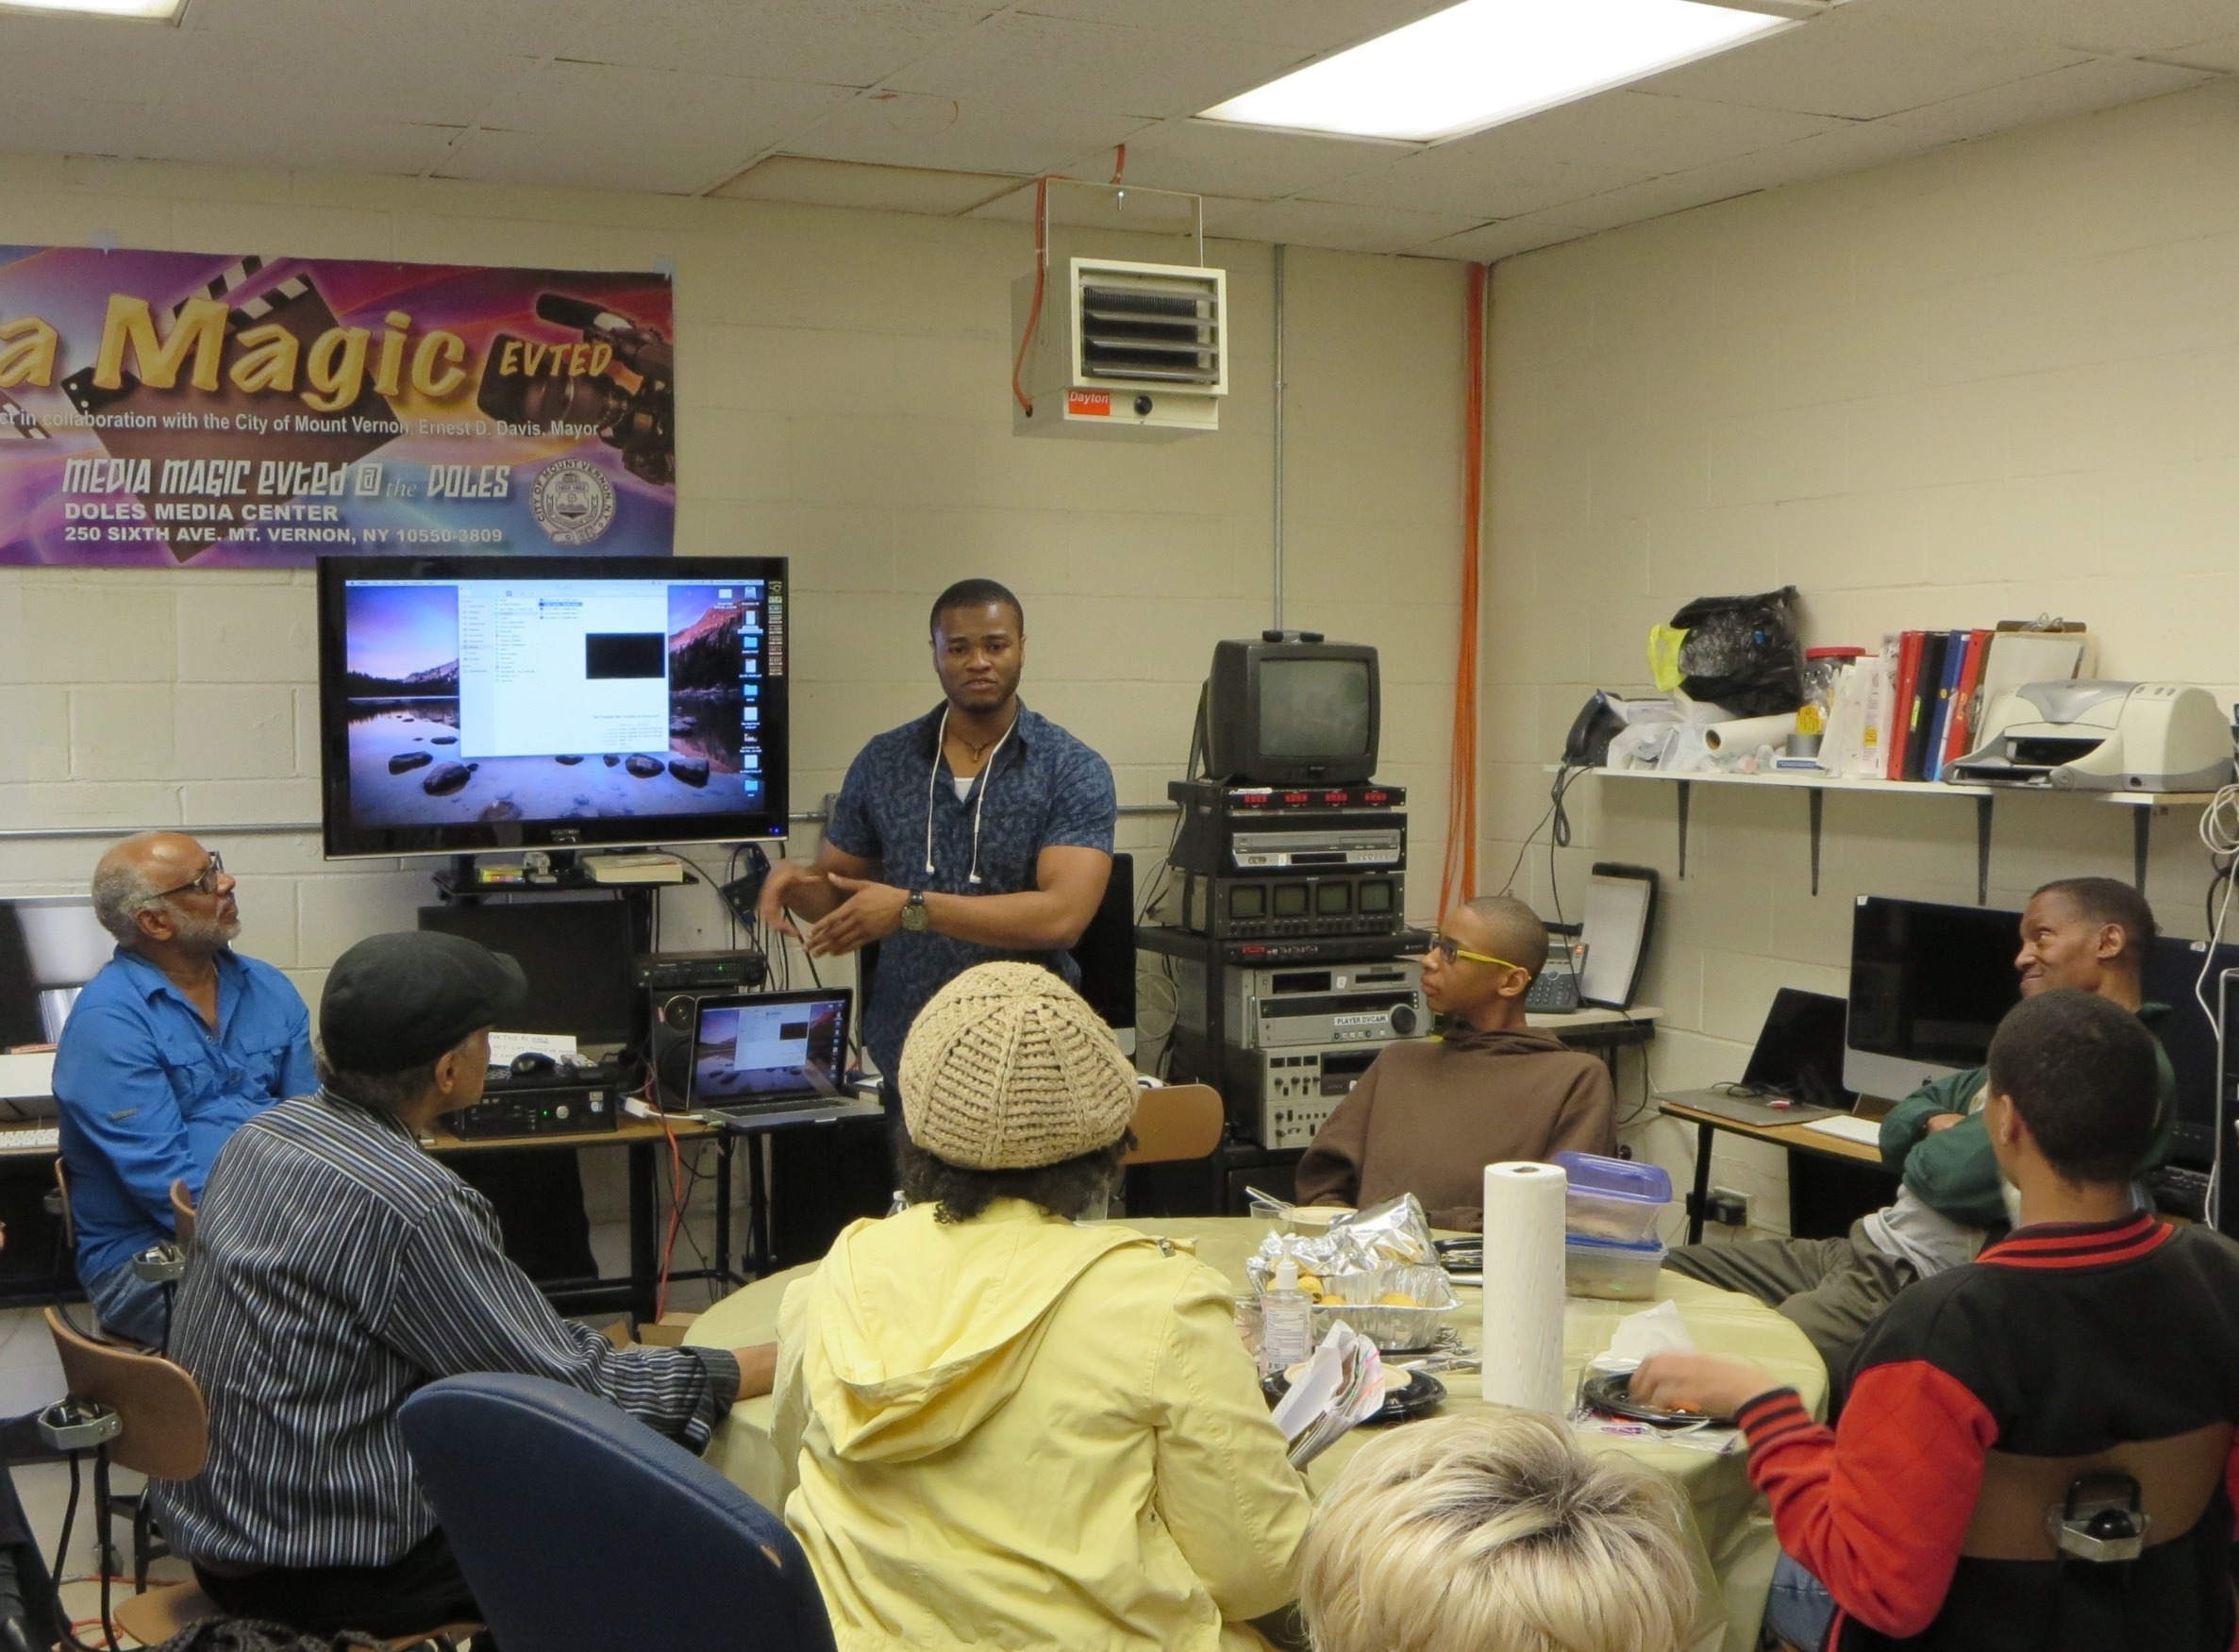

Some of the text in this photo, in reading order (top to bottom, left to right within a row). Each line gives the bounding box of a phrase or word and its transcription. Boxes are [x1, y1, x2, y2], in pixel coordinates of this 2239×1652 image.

[92, 292, 468, 411] Magic
[499, 341, 613, 377] EVTED
[1069, 391, 1109, 405] Dayton
[20, 409, 36, 426] in
[42, 409, 158, 428] collaboration
[162, 412, 198, 429] with
[204, 412, 230, 429] the
[235, 413, 268, 435] City
[273, 415, 291, 431] of
[294, 415, 347, 433] Mount
[419, 419, 471, 436] Ernest
[476, 421, 491, 436] D.
[497, 421, 545, 437] Davis,
[550, 421, 599, 440] Mayor
[355, 463, 383, 496] @
[385, 478, 417, 497] the
[426, 464, 511, 497] DOLES
[543, 459, 578, 478] MOUNT
[581, 461, 611, 499] VERNON
[534, 481, 543, 494] OF
[64, 502, 340, 523] DOLES MEDIA CENTER
[533, 499, 544, 522] CITY
[64, 526, 504, 545] 250 SIXTH AVE. MT. VERNON, NY 10550-3809
